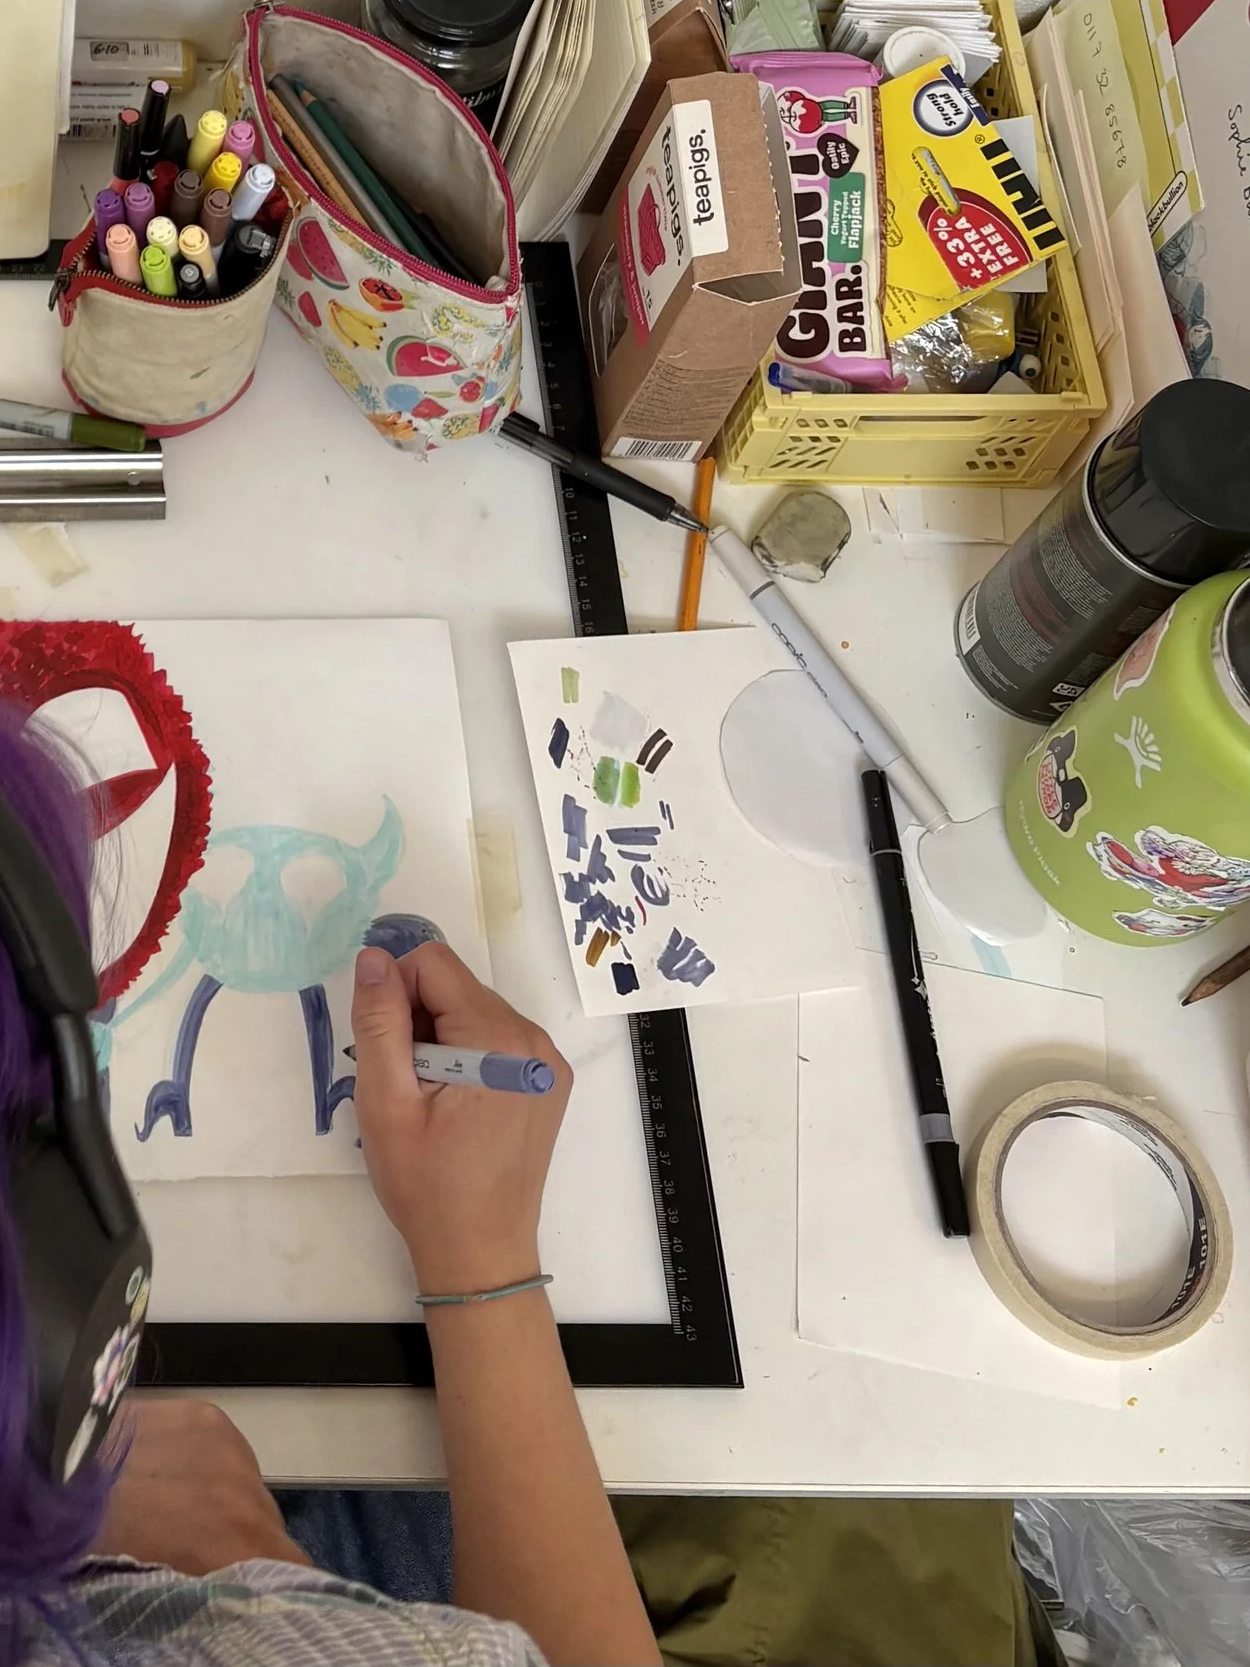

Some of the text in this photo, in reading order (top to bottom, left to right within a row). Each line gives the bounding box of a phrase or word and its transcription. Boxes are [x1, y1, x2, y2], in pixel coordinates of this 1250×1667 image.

[925, 92, 957, 128] Strong
[939, 91, 964, 117] hold
[830, 140, 840, 170] Oatily
[840, 142, 851, 165] Epic
[688, 129, 715, 226] teapigs.
[661, 125, 685, 267] teapigs.
[830, 199, 840, 236] Cherry
[848, 190, 862, 250] Flapjack
[954, 215, 1003, 274] EXTRA
[979, 222, 1019, 266] FREE
[835, 264, 867, 354] BAR.
[643, 1041, 655, 1056] 33
[647, 1068, 659, 1082] 34
[651, 1095, 663, 1110] 35
[655, 1123, 667, 1138] 36
[659, 1151, 671, 1166] 37
[663, 1180, 676, 1195] 38
[667, 1207, 680, 1224] 39
[672, 1236, 684, 1253] 40
[677, 1266, 688, 1281] 41
[681, 1295, 693, 1312] 42
[686, 1324, 698, 1341] 43
